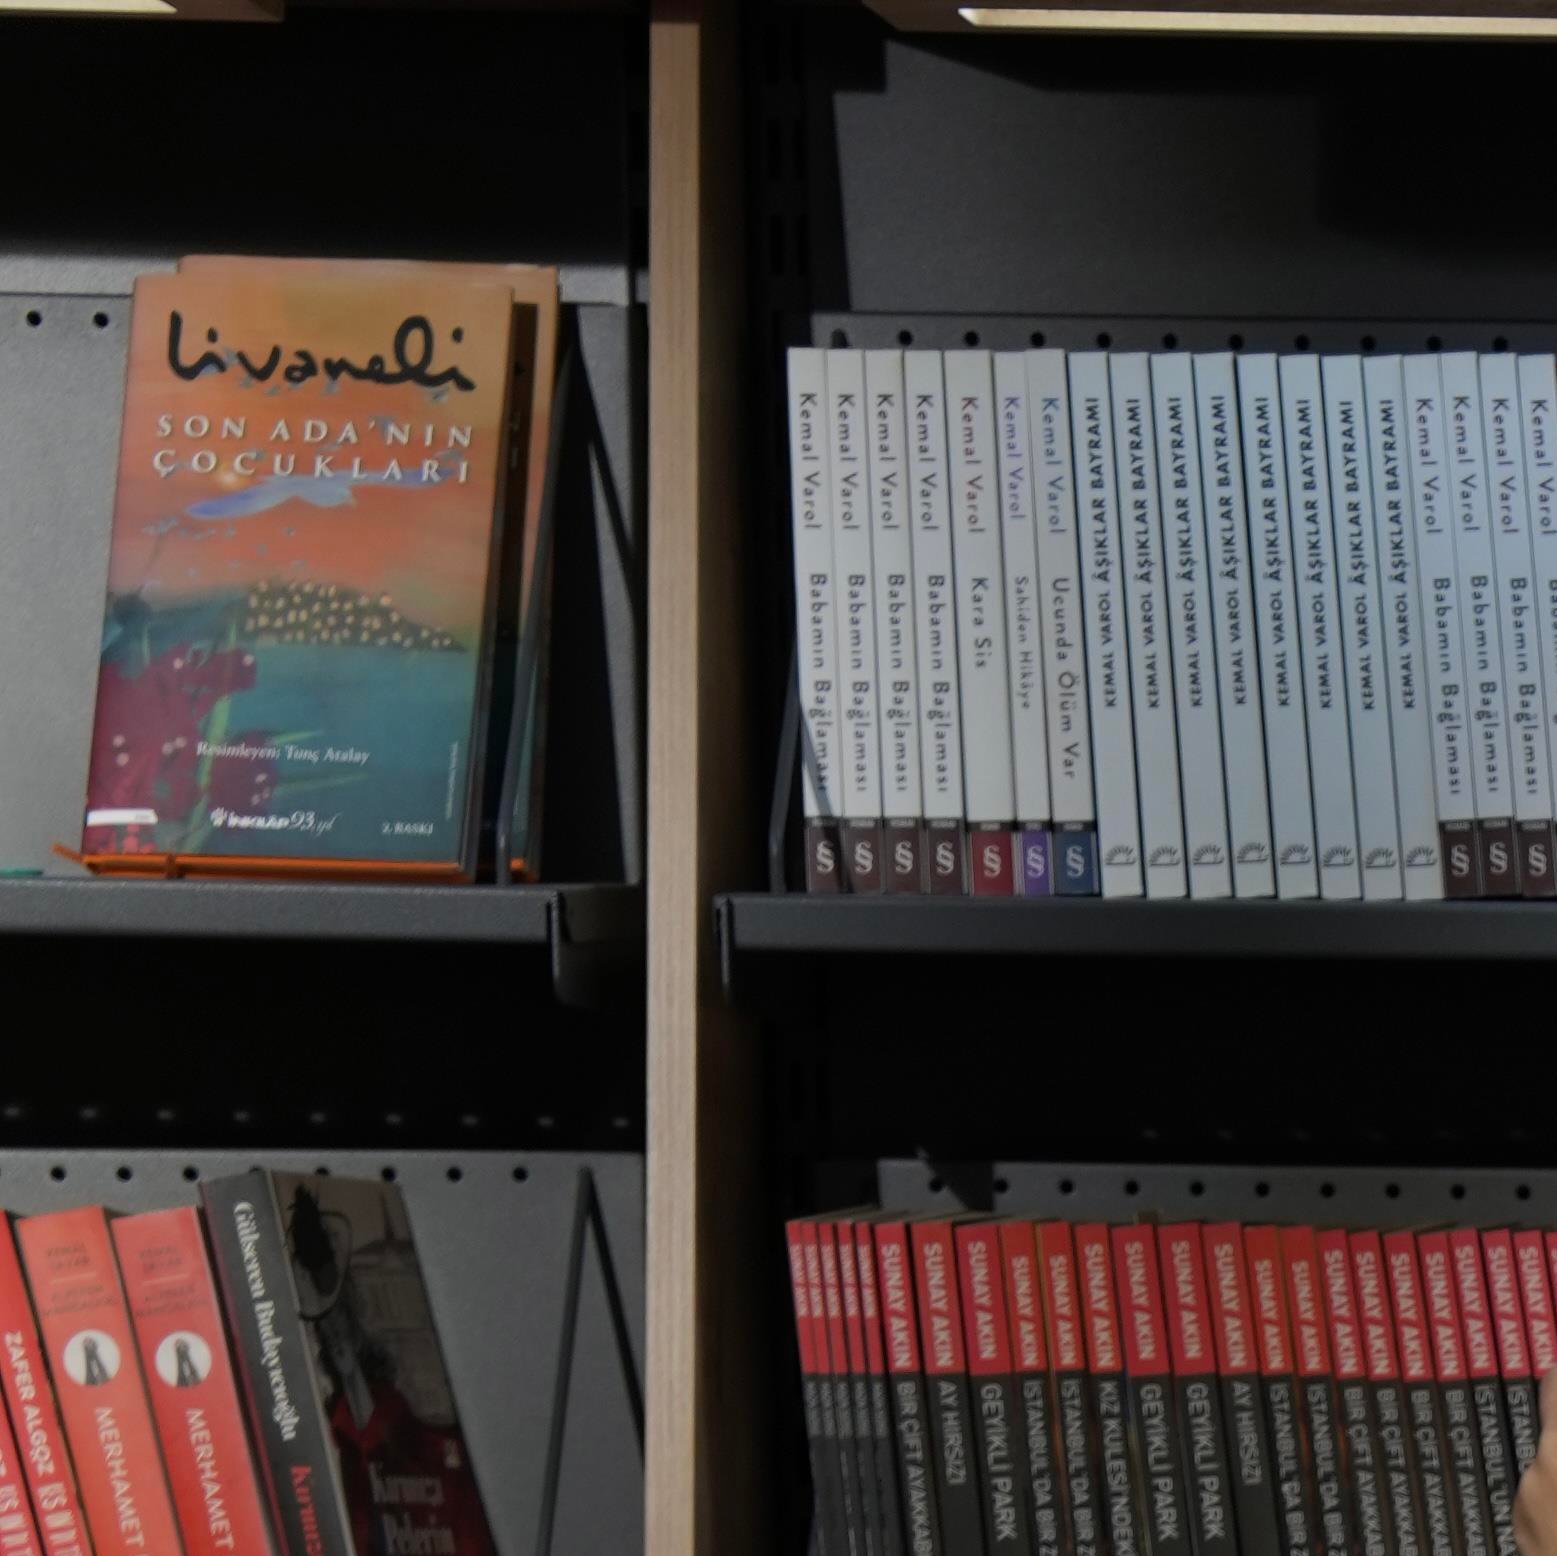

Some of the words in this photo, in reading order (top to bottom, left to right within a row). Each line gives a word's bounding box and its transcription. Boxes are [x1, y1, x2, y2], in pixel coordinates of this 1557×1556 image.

[156, 415, 246, 438] SON
[270, 419, 473, 447] ADA'NIN
[1042, 397, 1060, 466] Kemal
[1339, 401, 1360, 493] BAYRAMI
[1531, 399, 1552, 467] Kemal
[153, 449, 469, 483] ÇOCUKLARI
[1047, 476, 1066, 535] Varol
[1538, 478, 1557, 536] Varol
[1052, 578, 1071, 662] Ucunda
[1352, 595, 1369, 649] VAROL
[1058, 672, 1080, 733] Ölüm
[1360, 656, 1375, 712] KEMAL
[1062, 742, 1079, 780] Var
[232, 1201, 267, 1299] Gülseren
[185, 1408, 234, 1549] MERHAMET
